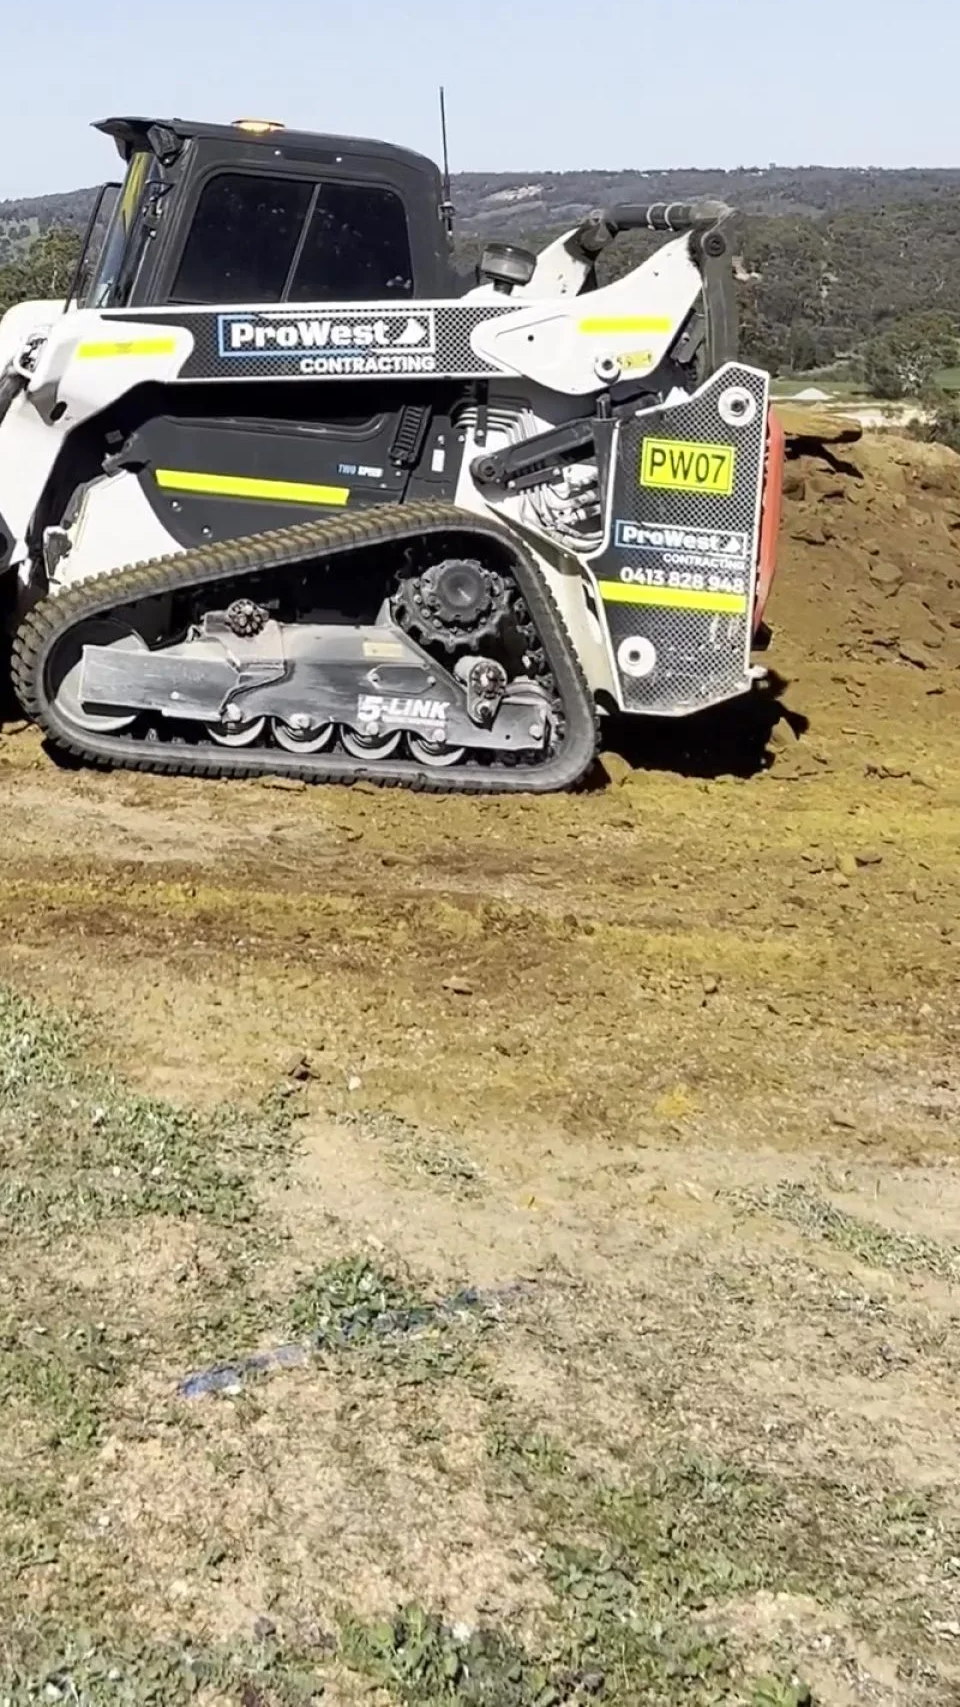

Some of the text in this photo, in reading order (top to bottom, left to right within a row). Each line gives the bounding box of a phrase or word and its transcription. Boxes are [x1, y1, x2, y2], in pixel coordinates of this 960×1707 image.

[230, 319, 390, 348] ProWest
[300, 355, 437, 374] CONTRACTING
[649, 446, 727, 484] PW07
[622, 525, 720, 552] ProWest
[662, 552, 746, 571] CONTRACTING
[620, 566, 746, 595] 0413 828 948
[357, 694, 451, 722] 5-LINK
